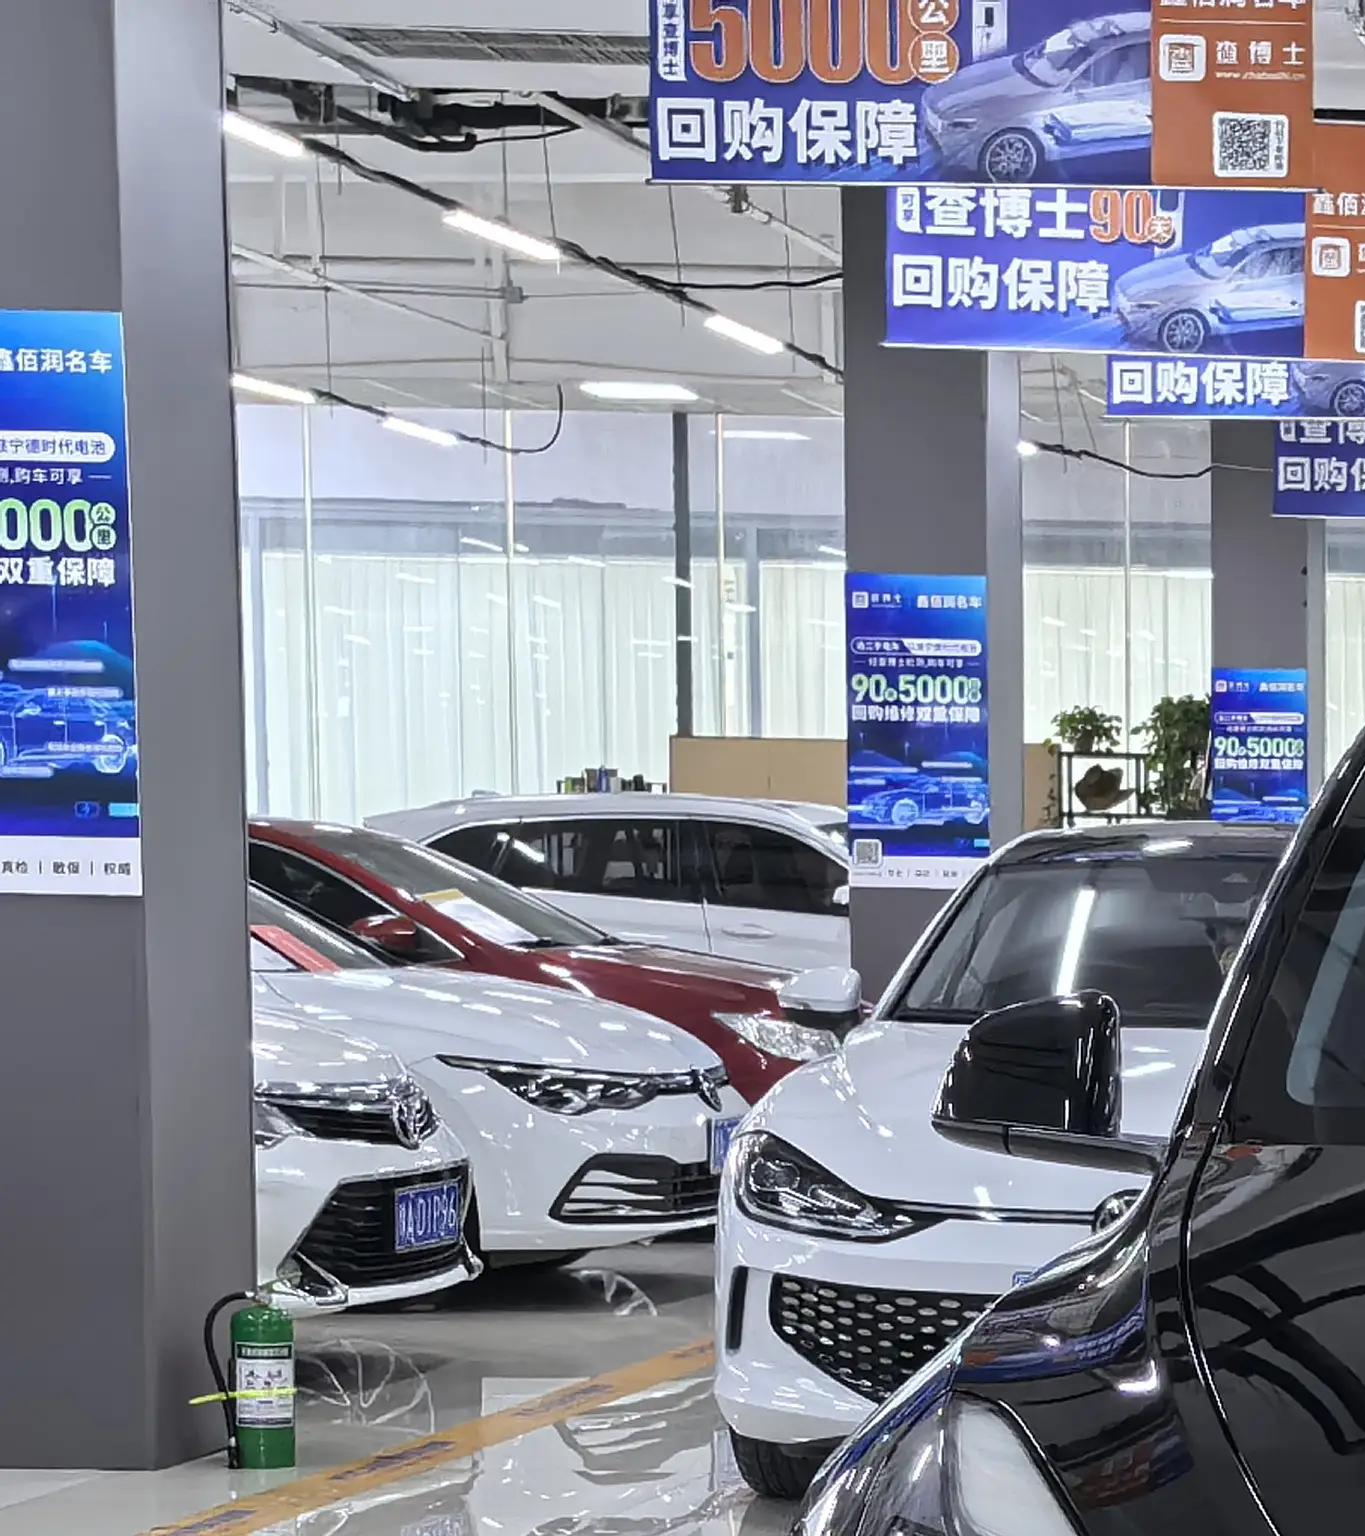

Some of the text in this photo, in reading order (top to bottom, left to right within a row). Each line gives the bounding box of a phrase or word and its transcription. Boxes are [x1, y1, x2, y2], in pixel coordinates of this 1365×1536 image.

[1215, 40, 1306, 66] 查博士
[657, 97, 918, 164] 回购保障
[892, 254, 1111, 313] 回购保障
[1111, 361, 1290, 407] 回购保障
